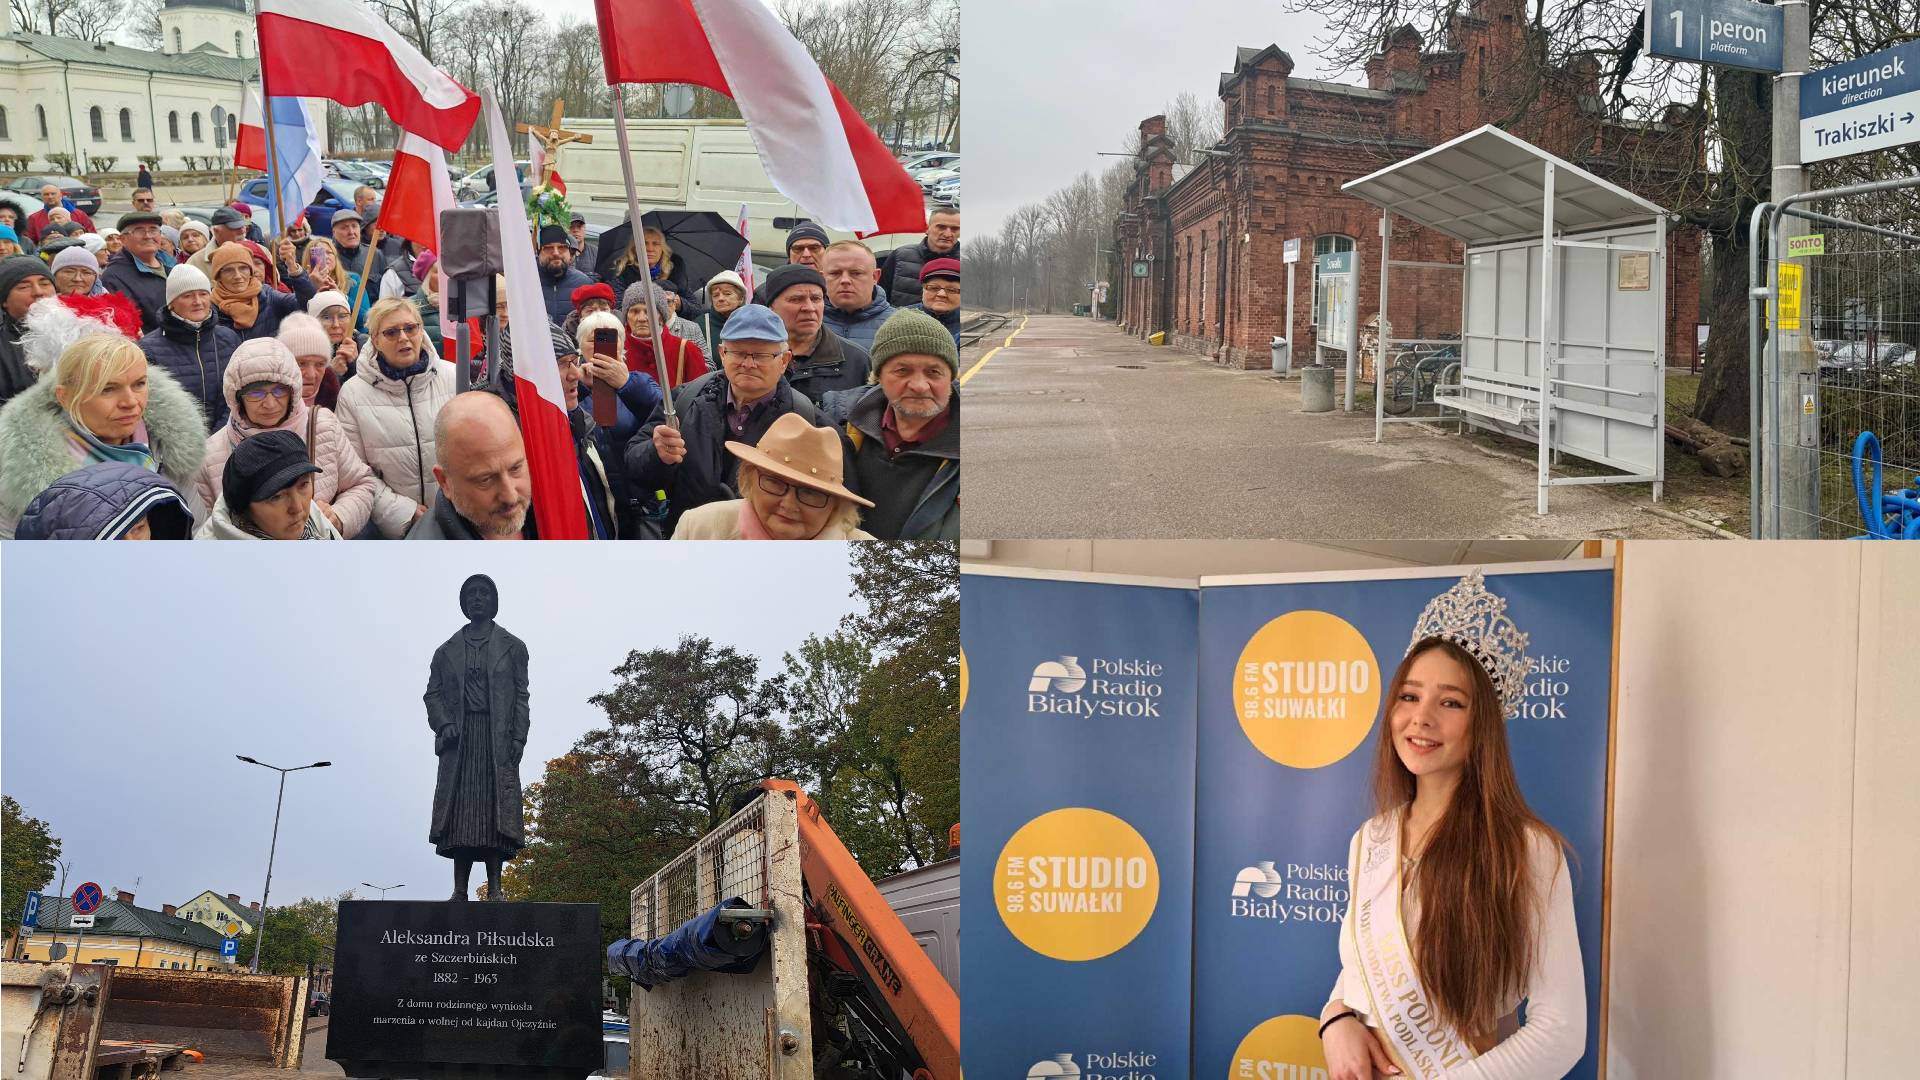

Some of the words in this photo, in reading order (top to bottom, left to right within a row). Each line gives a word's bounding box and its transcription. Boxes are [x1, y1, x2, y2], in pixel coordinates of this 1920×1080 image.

[1670, 10, 1683, 48] 1
[1710, 19, 1767, 44] peron
[1710, 41, 1748, 56] platform
[1822, 56, 1905, 97] kierunek
[1841, 86, 1883, 105] direction
[1815, 112, 1895, 147] Trakiszki
[1092, 658, 1163, 677] Polskie
[1244, 662, 1259, 682] FM
[1262, 660, 1369, 695] STUDIO
[1092, 679, 1162, 697] Radio
[1028, 693, 1160, 719] Białystok
[1263, 697, 1346, 719] SUWAŁKI
[1007, 856, 1024, 876] FM
[1028, 855, 1147, 889] STUDIO
[1286, 863, 1349, 882] Polskie
[1029, 891, 1122, 913] SUWAŁKI
[1286, 883, 1349, 902] Radio
[26, 896, 38, 921] P
[1231, 898, 1346, 924] Białystok
[224, 940, 235, 954] P
[380, 929, 470, 945] Aleksandra
[476, 931, 555, 947] Piłsudska
[414, 953, 428, 963] ze
[431, 952, 518, 965] Szczerbińskich
[433, 972, 458, 984] 1882
[474, 973, 498, 985] 1963
[397, 998, 405, 1008] Z
[406, 999, 433, 1008] domu
[436, 1000, 488, 1012] rodzinnego
[491, 1001, 533, 1013] wyniosła
[1379, 931, 1409, 988] MISS
[1398, 987, 1463, 1071] POLONI
[372, 1015, 416, 1025] marzenia
[428, 1016, 459, 1028] wolnej
[461, 1017, 473, 1026] od
[476, 1017, 508, 1029] kajdan
[511, 1019, 557, 1031] Ojczyźnie
[1086, 1051, 1157, 1069] Polskie
[1240, 1058, 1254, 1078] FM
[1257, 1060, 1328, 1080] STUD
